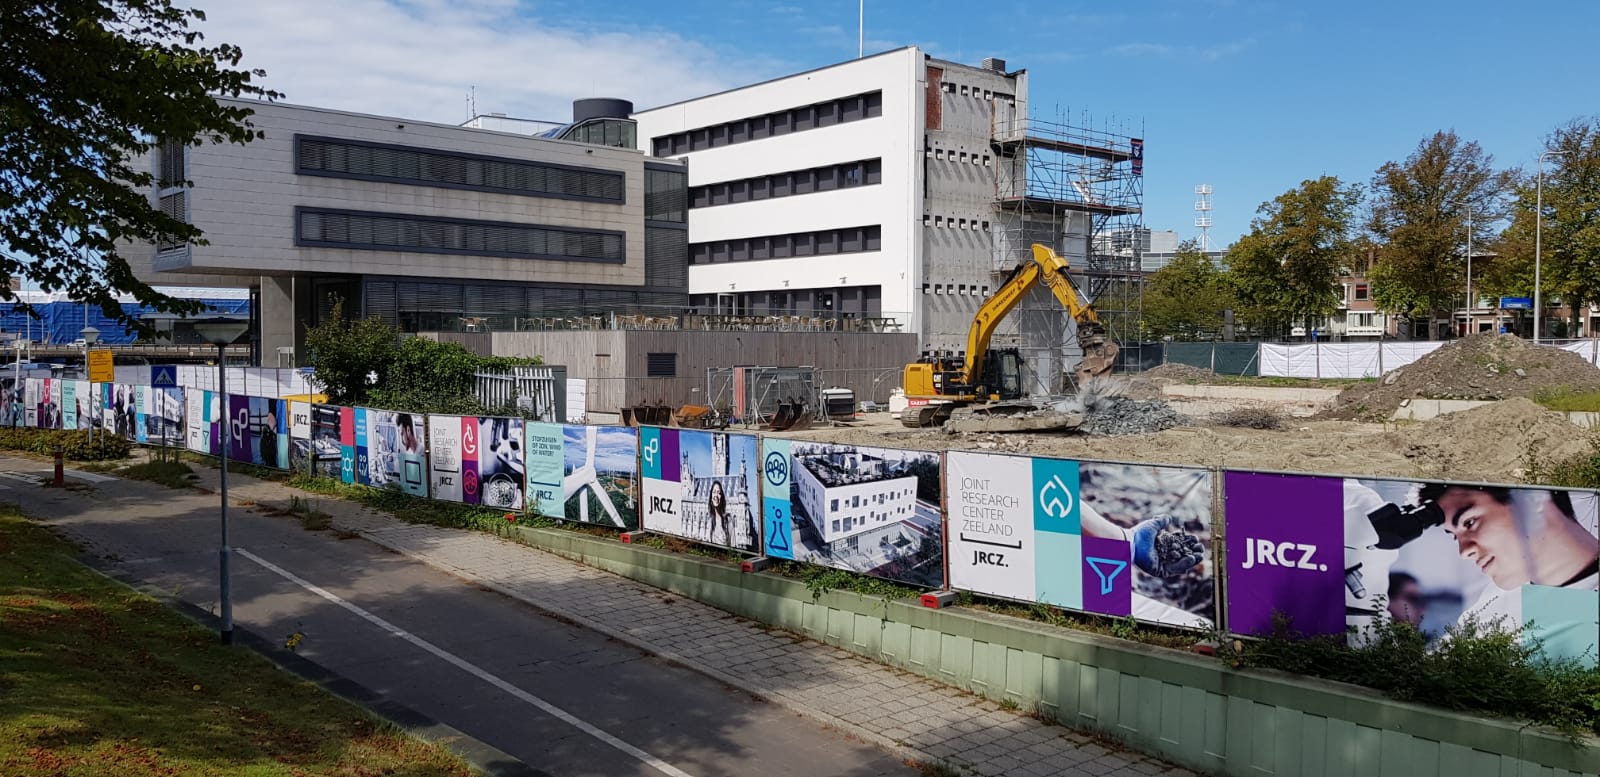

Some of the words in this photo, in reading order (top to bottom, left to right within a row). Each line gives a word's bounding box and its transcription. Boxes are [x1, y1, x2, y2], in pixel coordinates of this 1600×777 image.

[960, 477, 990, 491] JOINT
[649, 496, 676, 515] JRCZ.
[962, 491, 1018, 508] RESEARCH
[962, 506, 1004, 521] CENTER
[963, 520, 1013, 536] ZEELAND
[972, 550, 1009, 567] JRCZ.
[1242, 538, 1328, 572] JRCZ.
